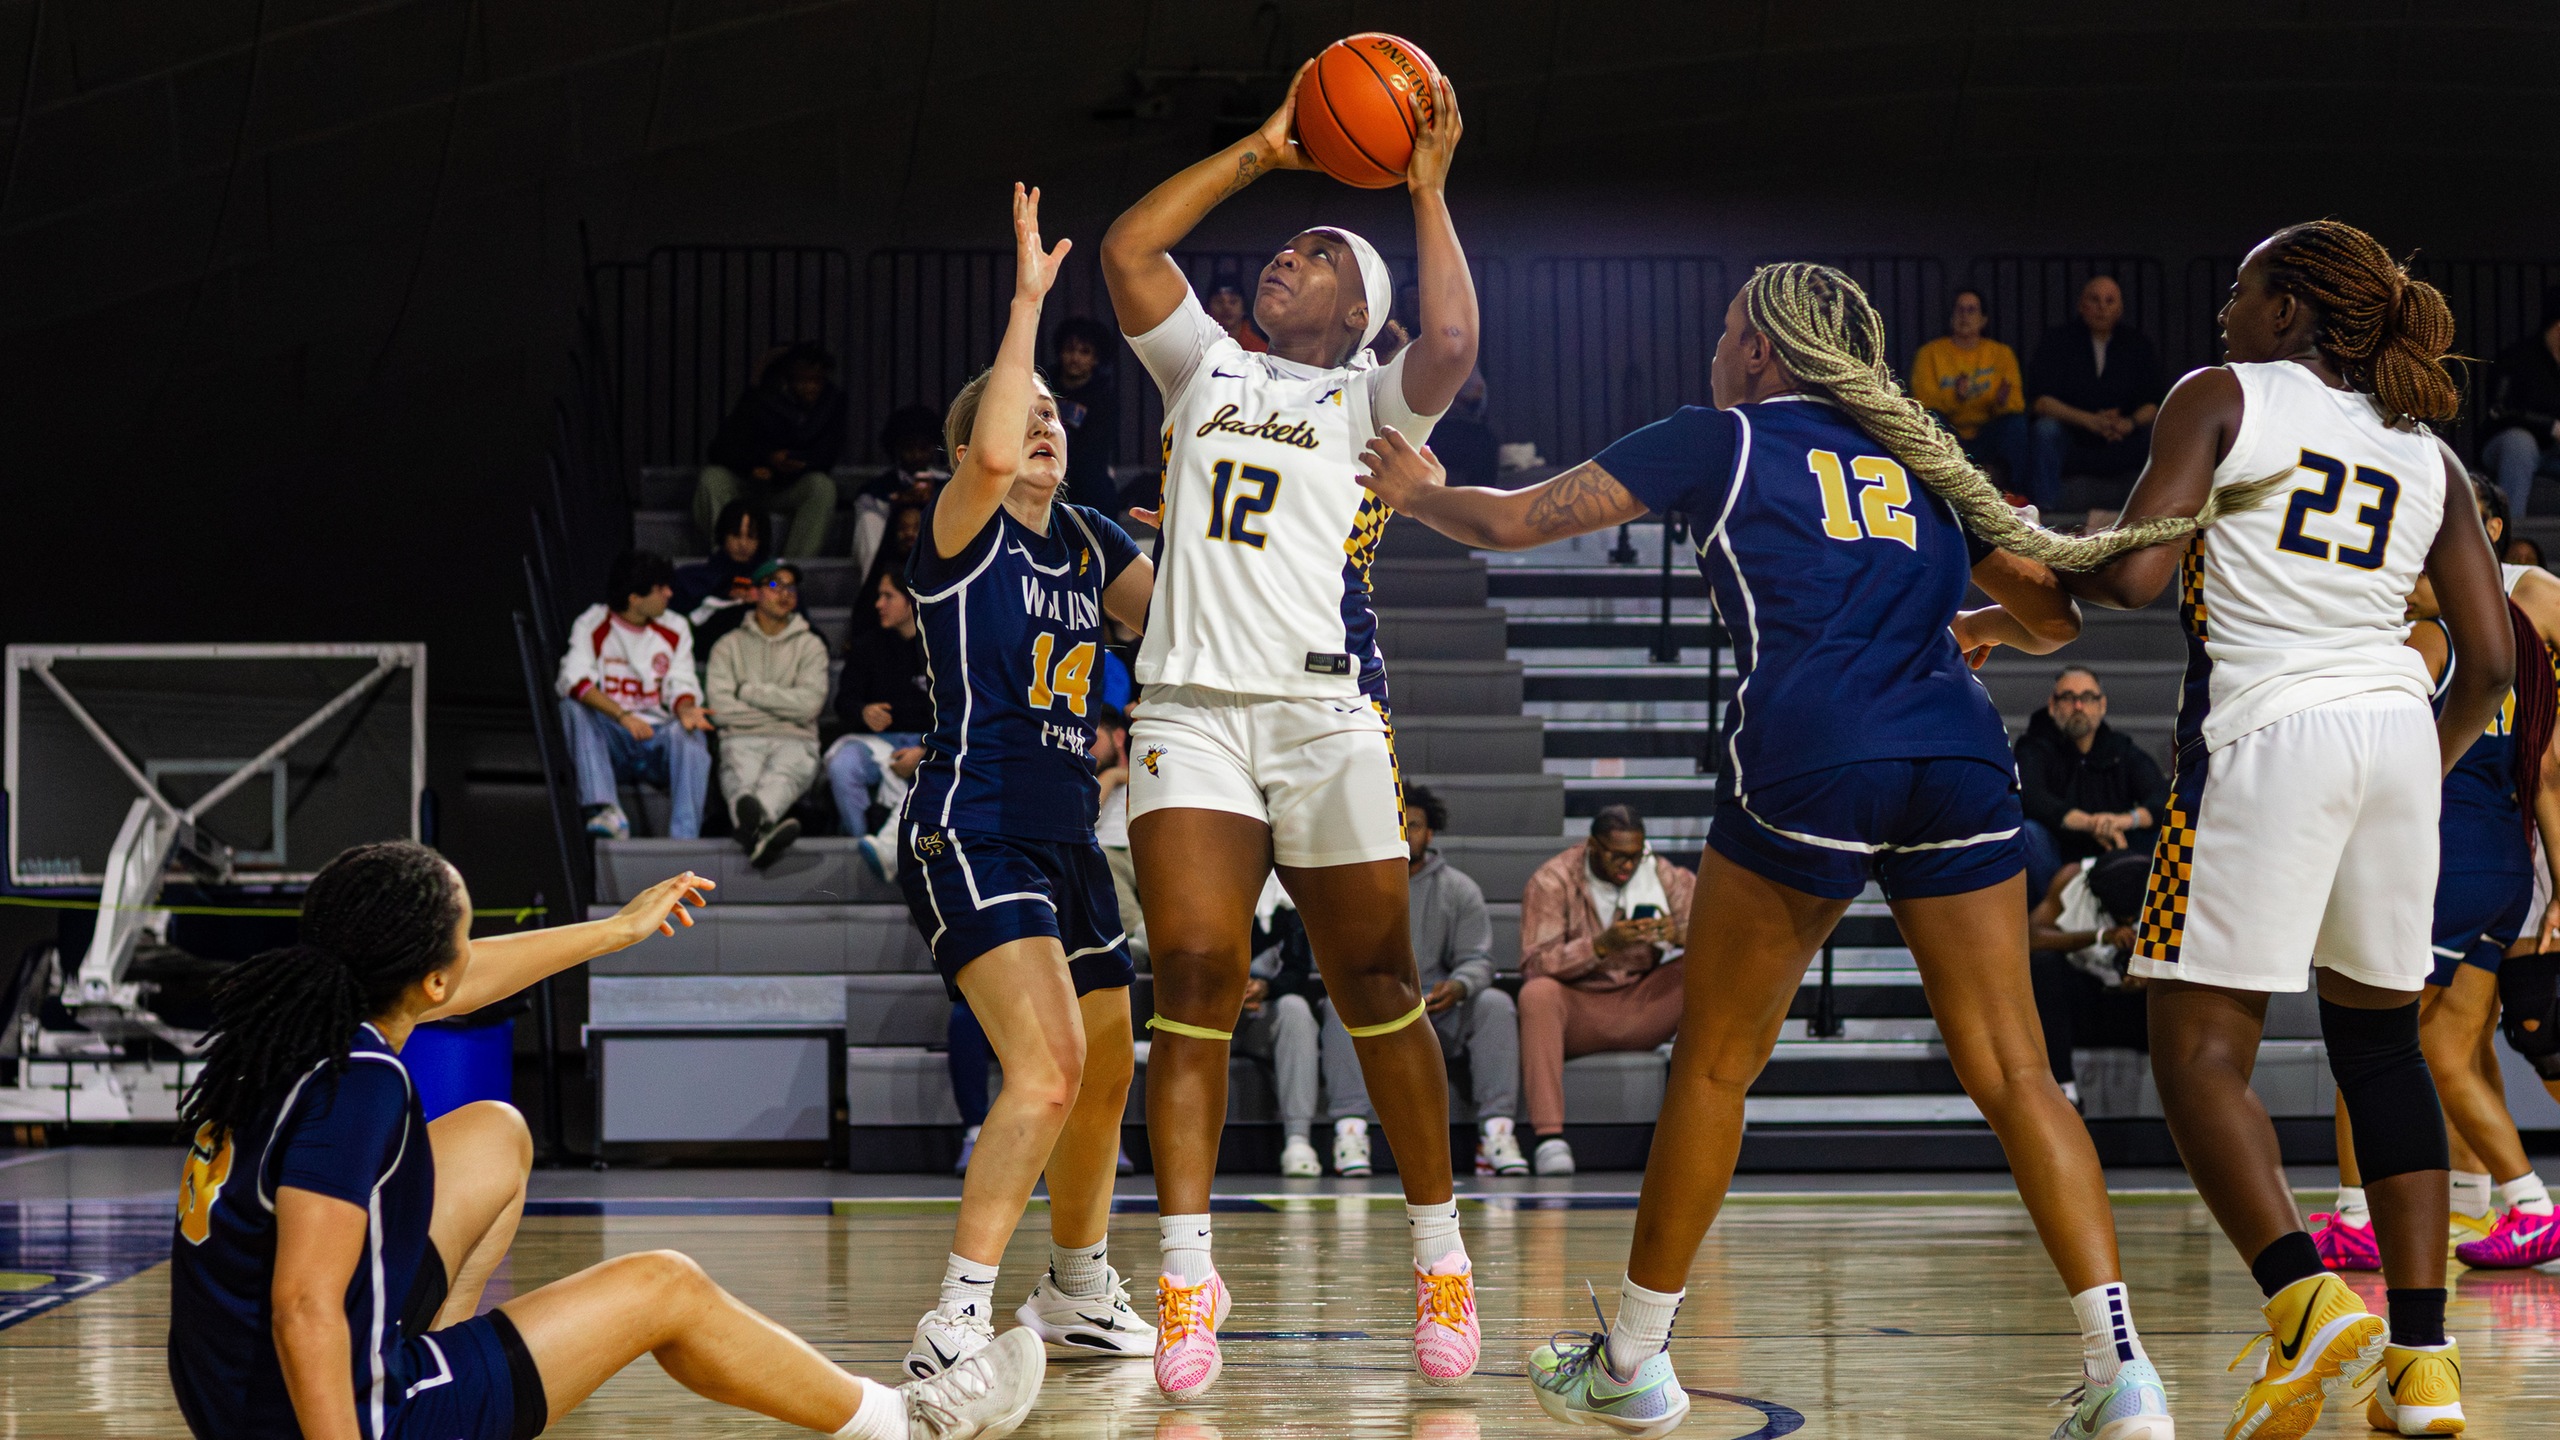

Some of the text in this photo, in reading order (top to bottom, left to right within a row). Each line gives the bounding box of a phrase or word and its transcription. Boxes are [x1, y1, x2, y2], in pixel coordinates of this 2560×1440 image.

[1371, 39, 1435, 122] PALDING
[1197, 404, 1319, 449] Jackets
[1205, 458, 1282, 551] 12
[1807, 448, 1917, 551] 12
[2276, 447, 2402, 572] 23
[1028, 631, 1096, 717] 14
[1337, 659, 1346, 669] M
